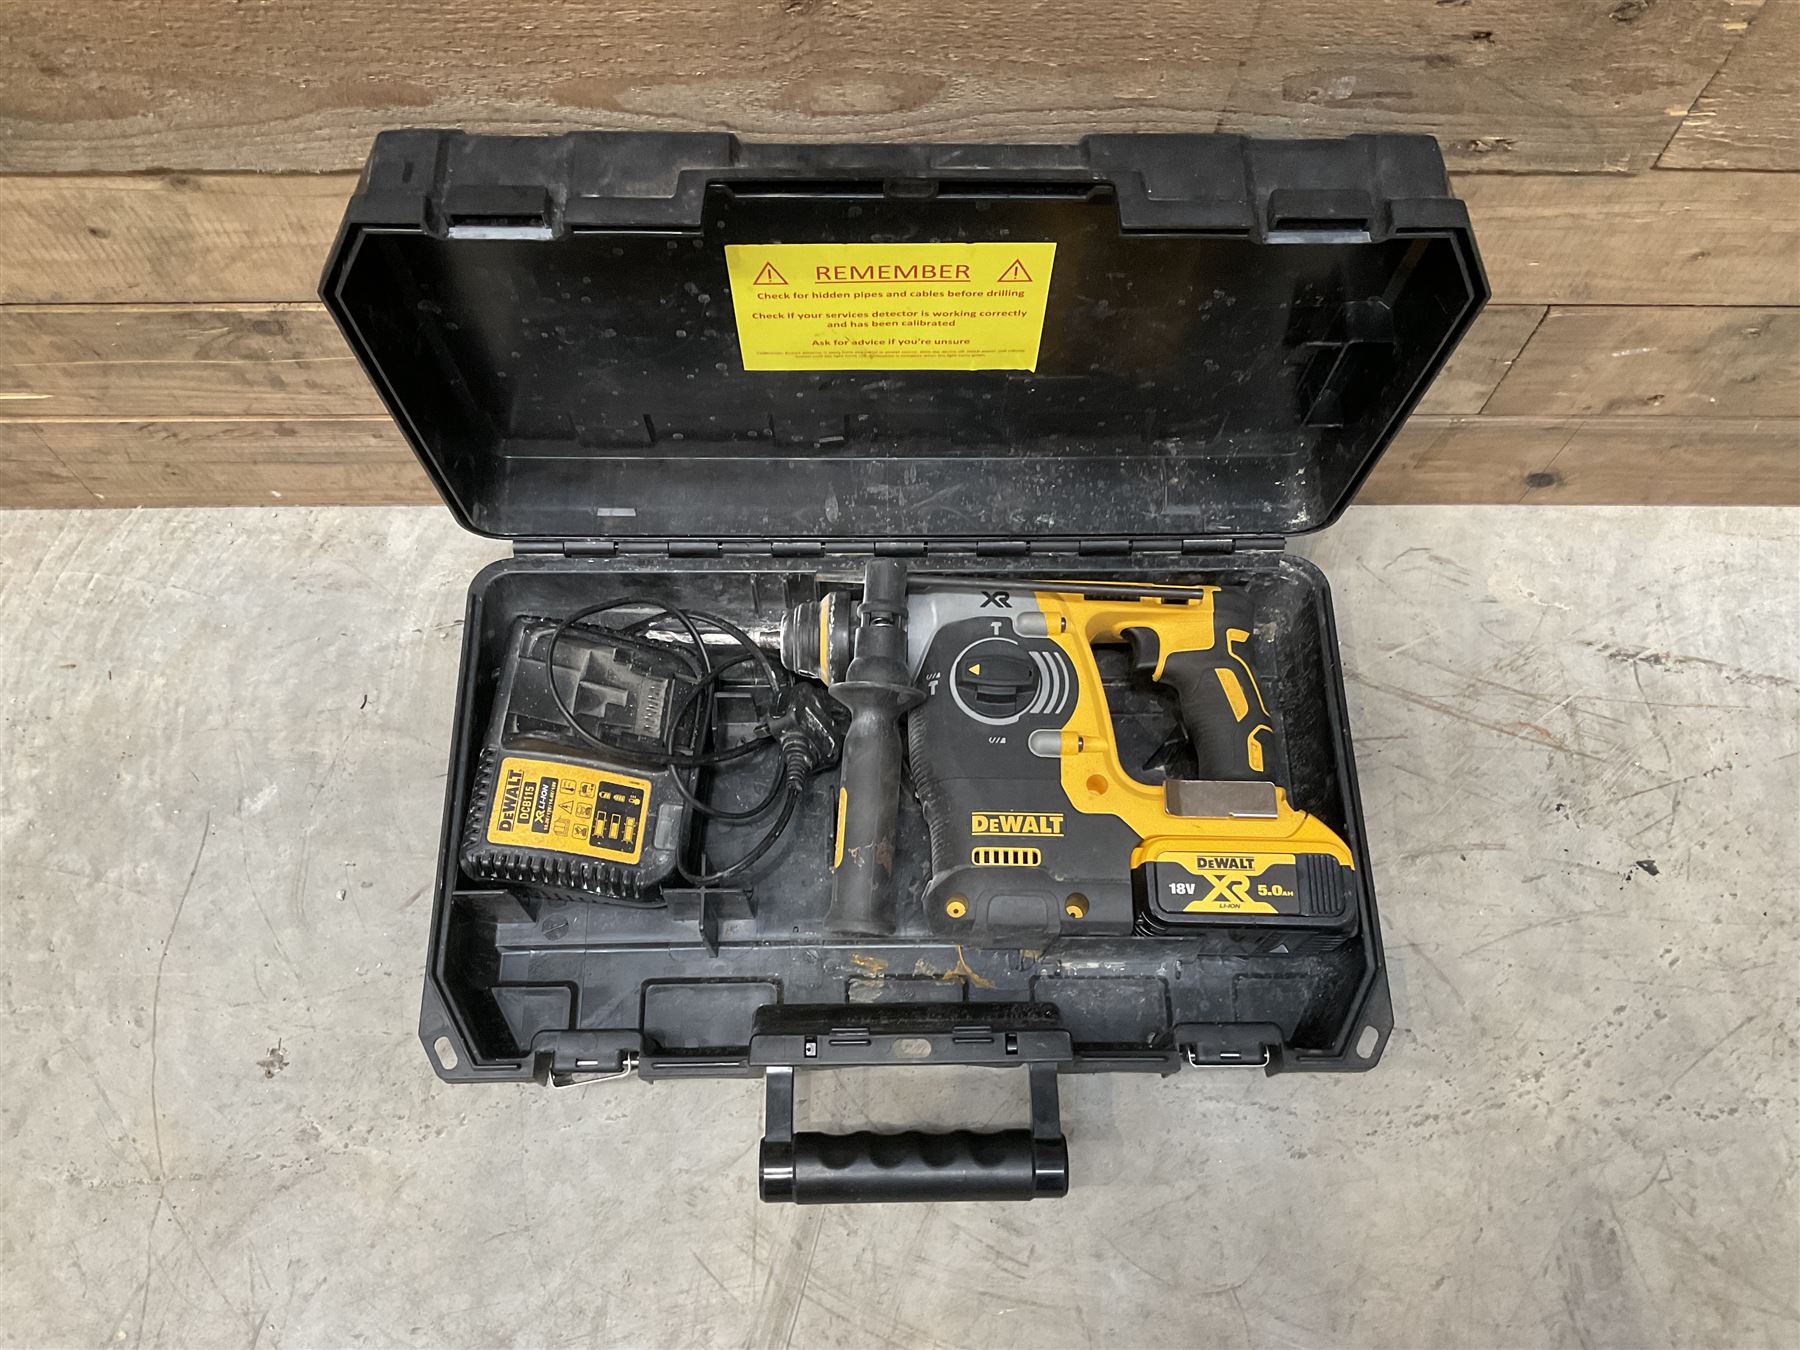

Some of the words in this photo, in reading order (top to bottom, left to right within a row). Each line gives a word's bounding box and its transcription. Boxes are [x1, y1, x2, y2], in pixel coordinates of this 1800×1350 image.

[816, 264, 970, 280] REMEMBER
[757, 291, 790, 299] Check
[794, 290, 808, 299] for
[812, 290, 850, 299] hidden
[854, 290, 882, 299] pipes
[887, 290, 906, 298] and
[910, 290, 944, 298] cables
[948, 289, 983, 298] before
[986, 289, 1024, 299] drilling
[752, 311, 784, 319] Check
[787, 311, 794, 319] if
[798, 312, 822, 320] your
[826, 311, 868, 319] services
[872, 310, 918, 318] detector
[921, 310, 930, 318] is
[933, 310, 976, 318] working
[980, 309, 1027, 318] correctly
[850, 320, 868, 328] has
[902, 319, 955, 327] calibrated
[899, 338, 931, 347] you're
[980, 592, 1012, 608] XR
[520, 786, 534, 819] DCB115
[534, 810, 545, 823] XR
[1169, 883, 1195, 895] 18V
[1203, 875, 1250, 902] XR
